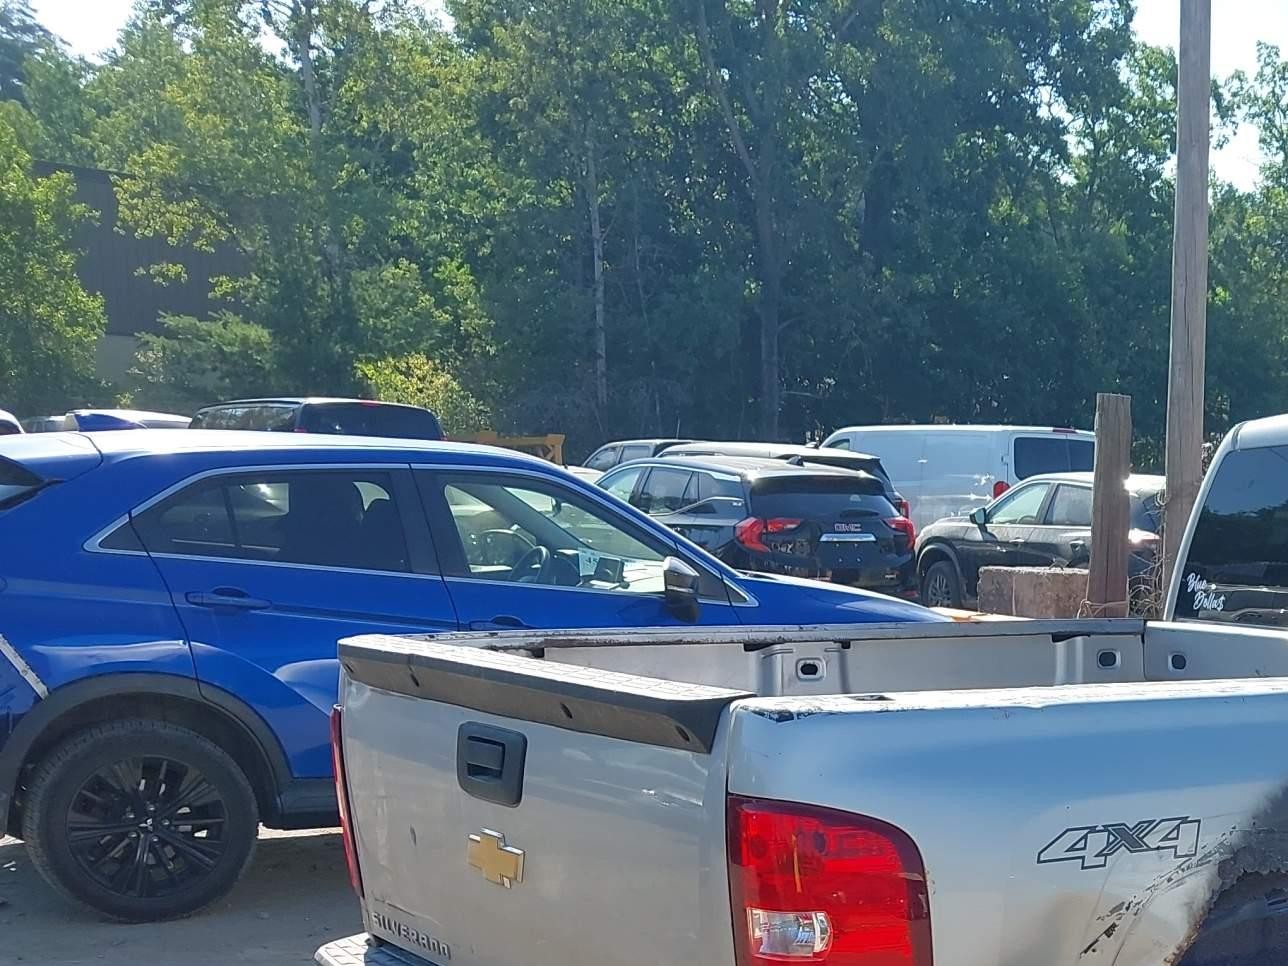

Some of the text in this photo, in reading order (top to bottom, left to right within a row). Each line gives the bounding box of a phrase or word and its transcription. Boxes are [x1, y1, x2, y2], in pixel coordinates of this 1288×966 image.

[834, 523, 862, 532] GMC
[1186, 572, 1208, 593] Blue
[371, 911, 452, 961] SILVERADO
